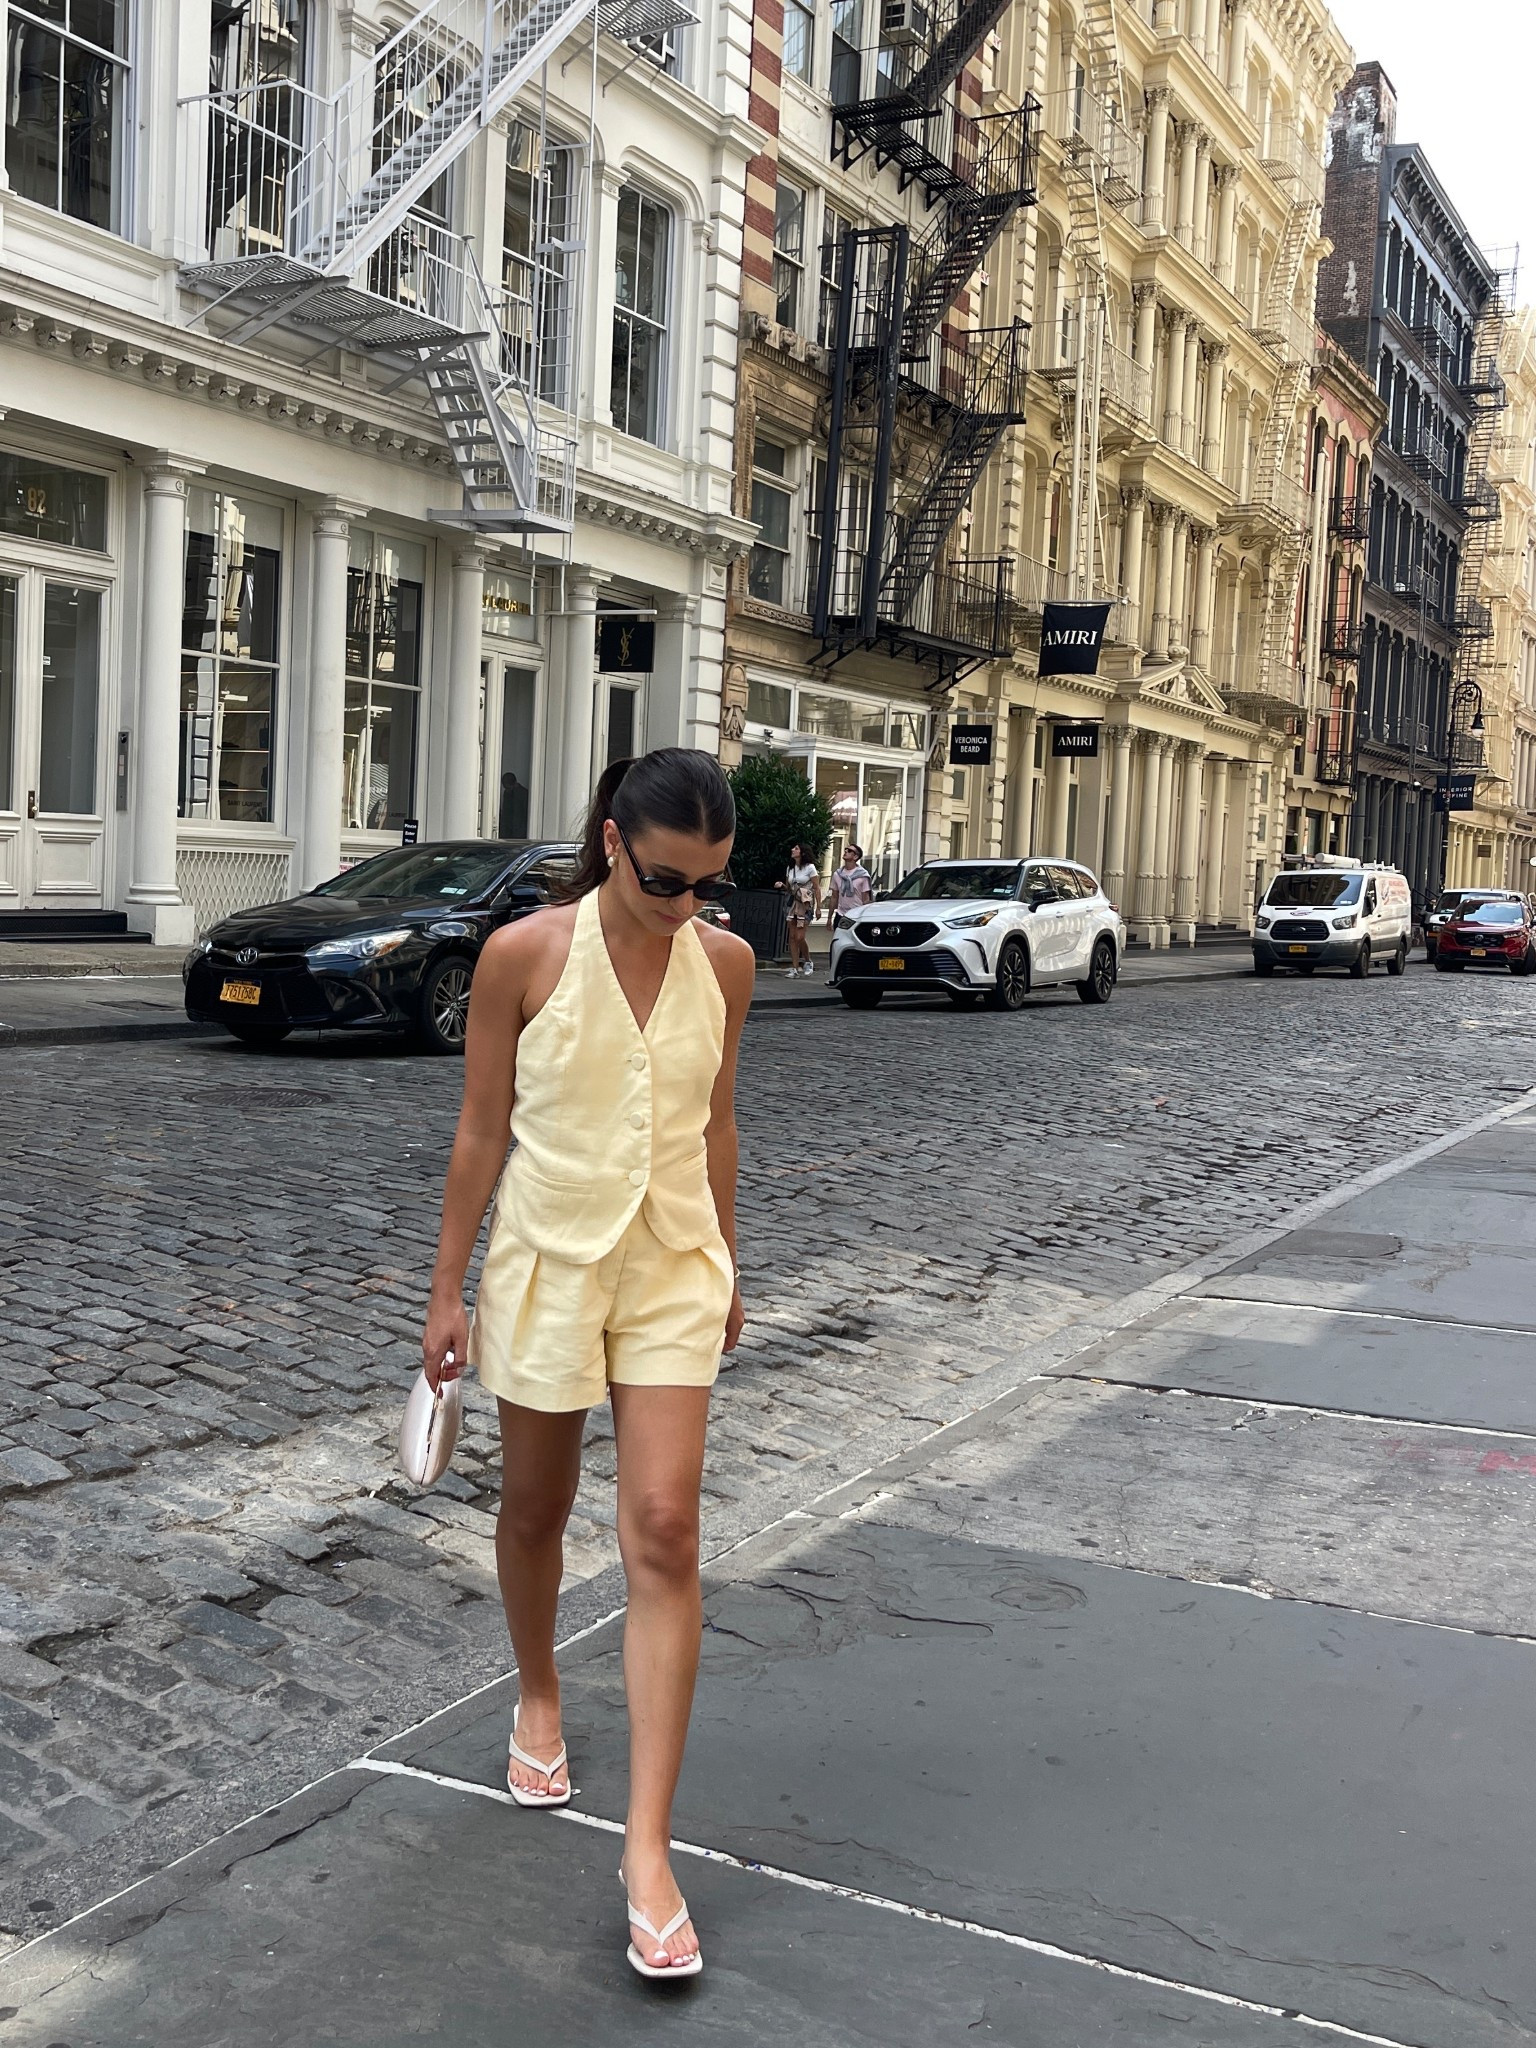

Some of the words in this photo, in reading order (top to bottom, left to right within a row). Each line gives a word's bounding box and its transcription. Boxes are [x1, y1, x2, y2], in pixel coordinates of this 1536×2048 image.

[27, 487, 47, 513] 82
[1043, 630, 1098, 646] AMIRI
[954, 736, 988, 745] VERONICA
[1057, 735, 1093, 746] AMIRI
[960, 745, 980, 753] BEARD
